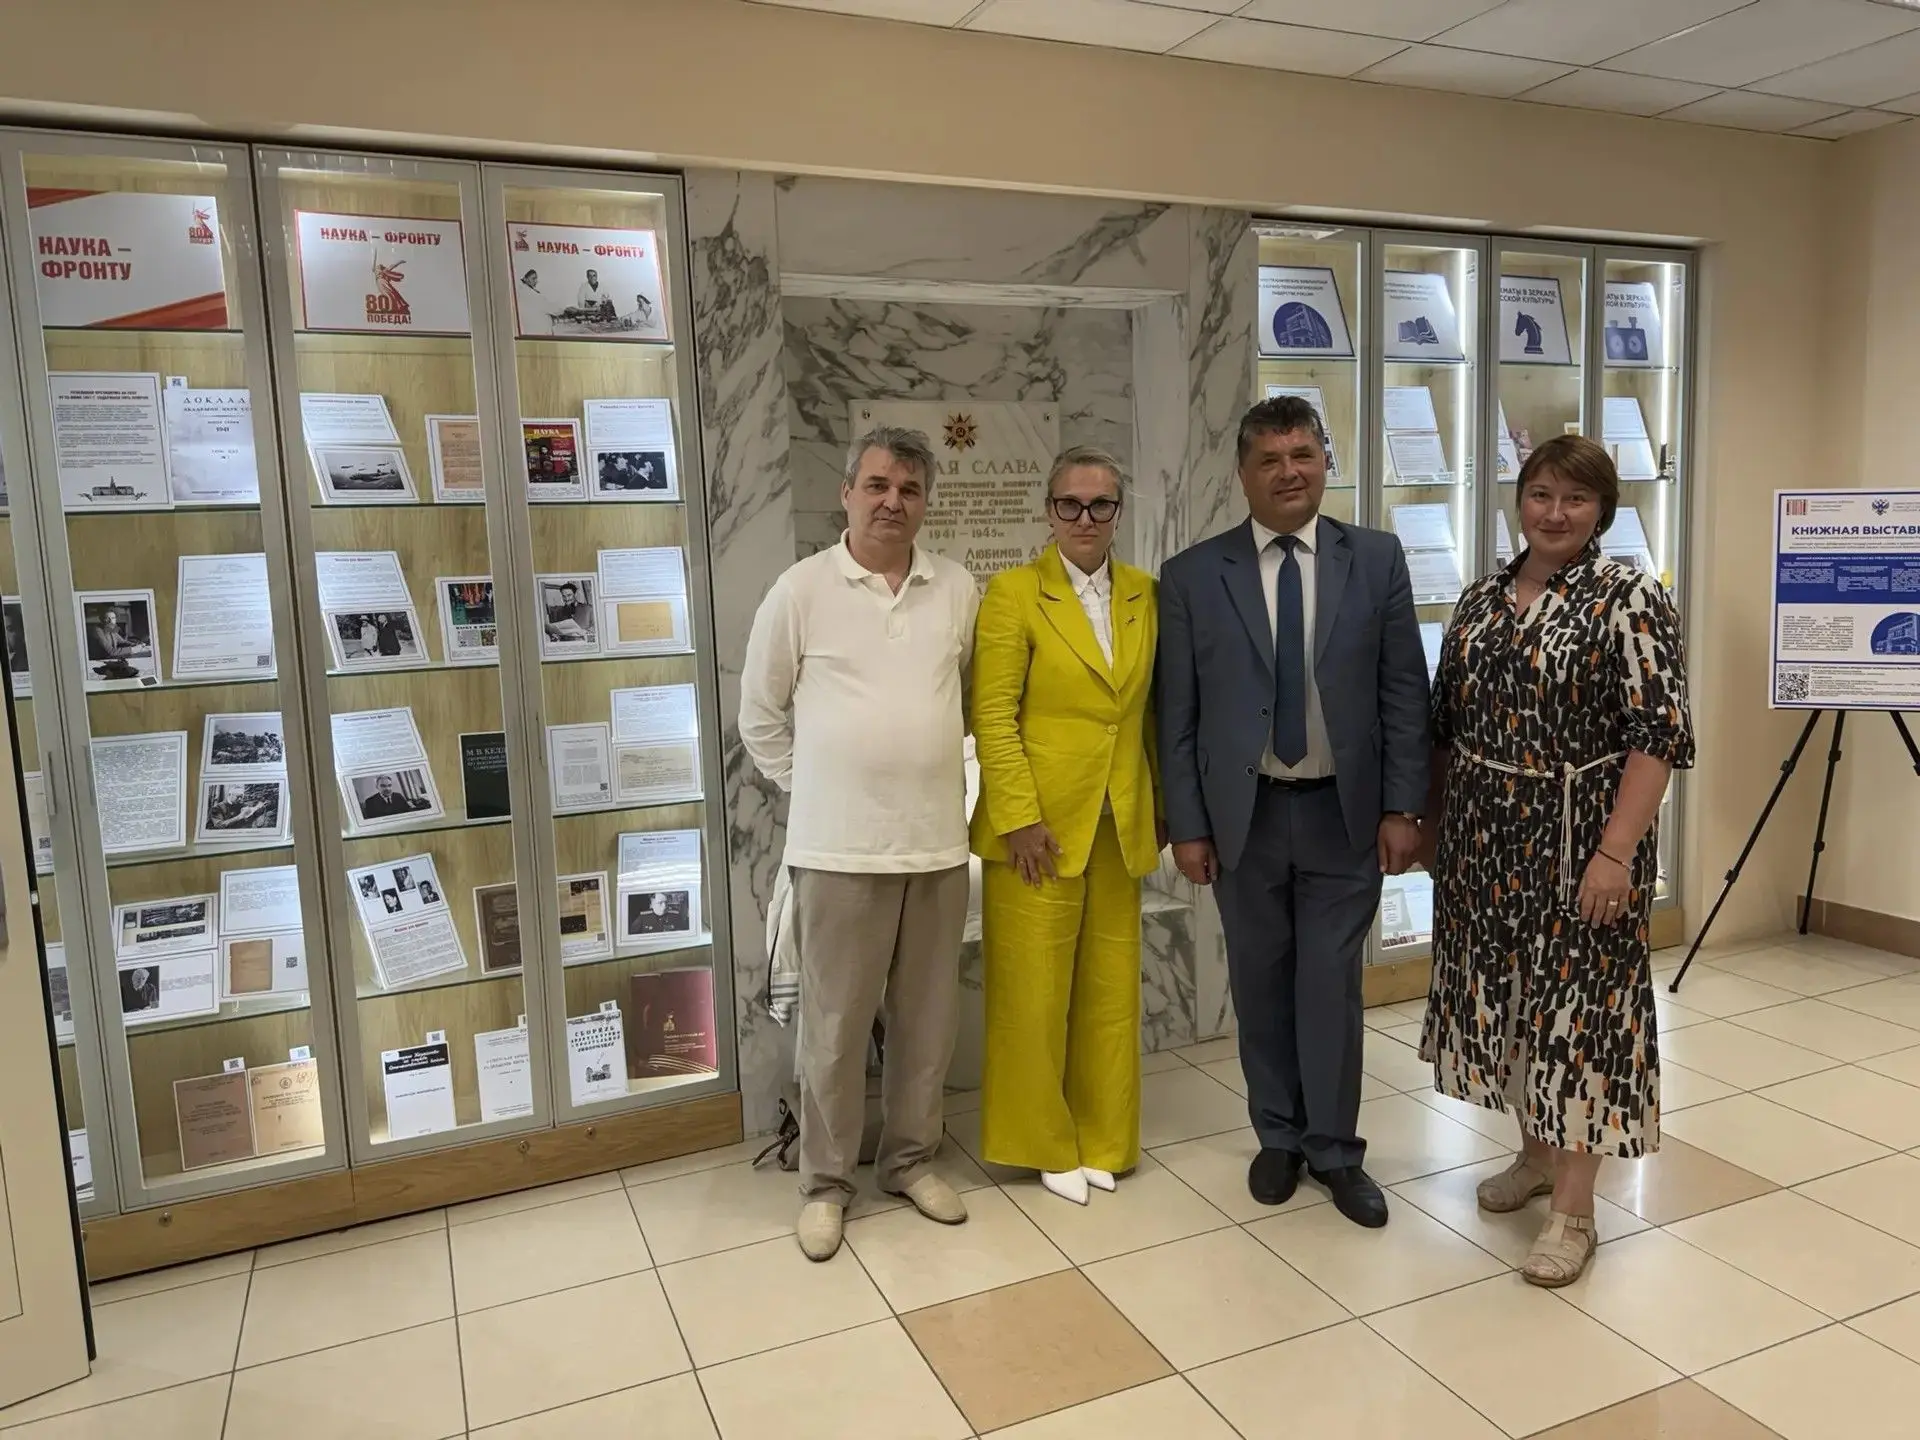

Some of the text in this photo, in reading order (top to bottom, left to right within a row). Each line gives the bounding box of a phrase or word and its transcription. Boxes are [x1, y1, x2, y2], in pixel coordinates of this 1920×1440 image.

[320, 227, 368, 242] НАУКА
[384, 231, 442, 246] ФРОНТУ
[38, 235, 112, 257] НАУКА
[536, 240, 579, 256] НАУКА
[594, 244, 646, 259] ФРОНТУ
[41, 260, 132, 281] ФРОНТУ
[1499, 295, 1555, 304] ССКОЙ КУЛЬТУРЫ
[1606, 293, 1620, 301] АТЫ
[367, 313, 412, 325] ПОБЕДА!
[183, 396, 249, 404] ДОКЛАД
[971, 459, 1042, 475] СЛАВА
[928, 528, 956, 540] 1941
[1791, 526, 1860, 535] КНИЖНАЯ
[965, 547, 1023, 560] ЛЮБИМОВ
